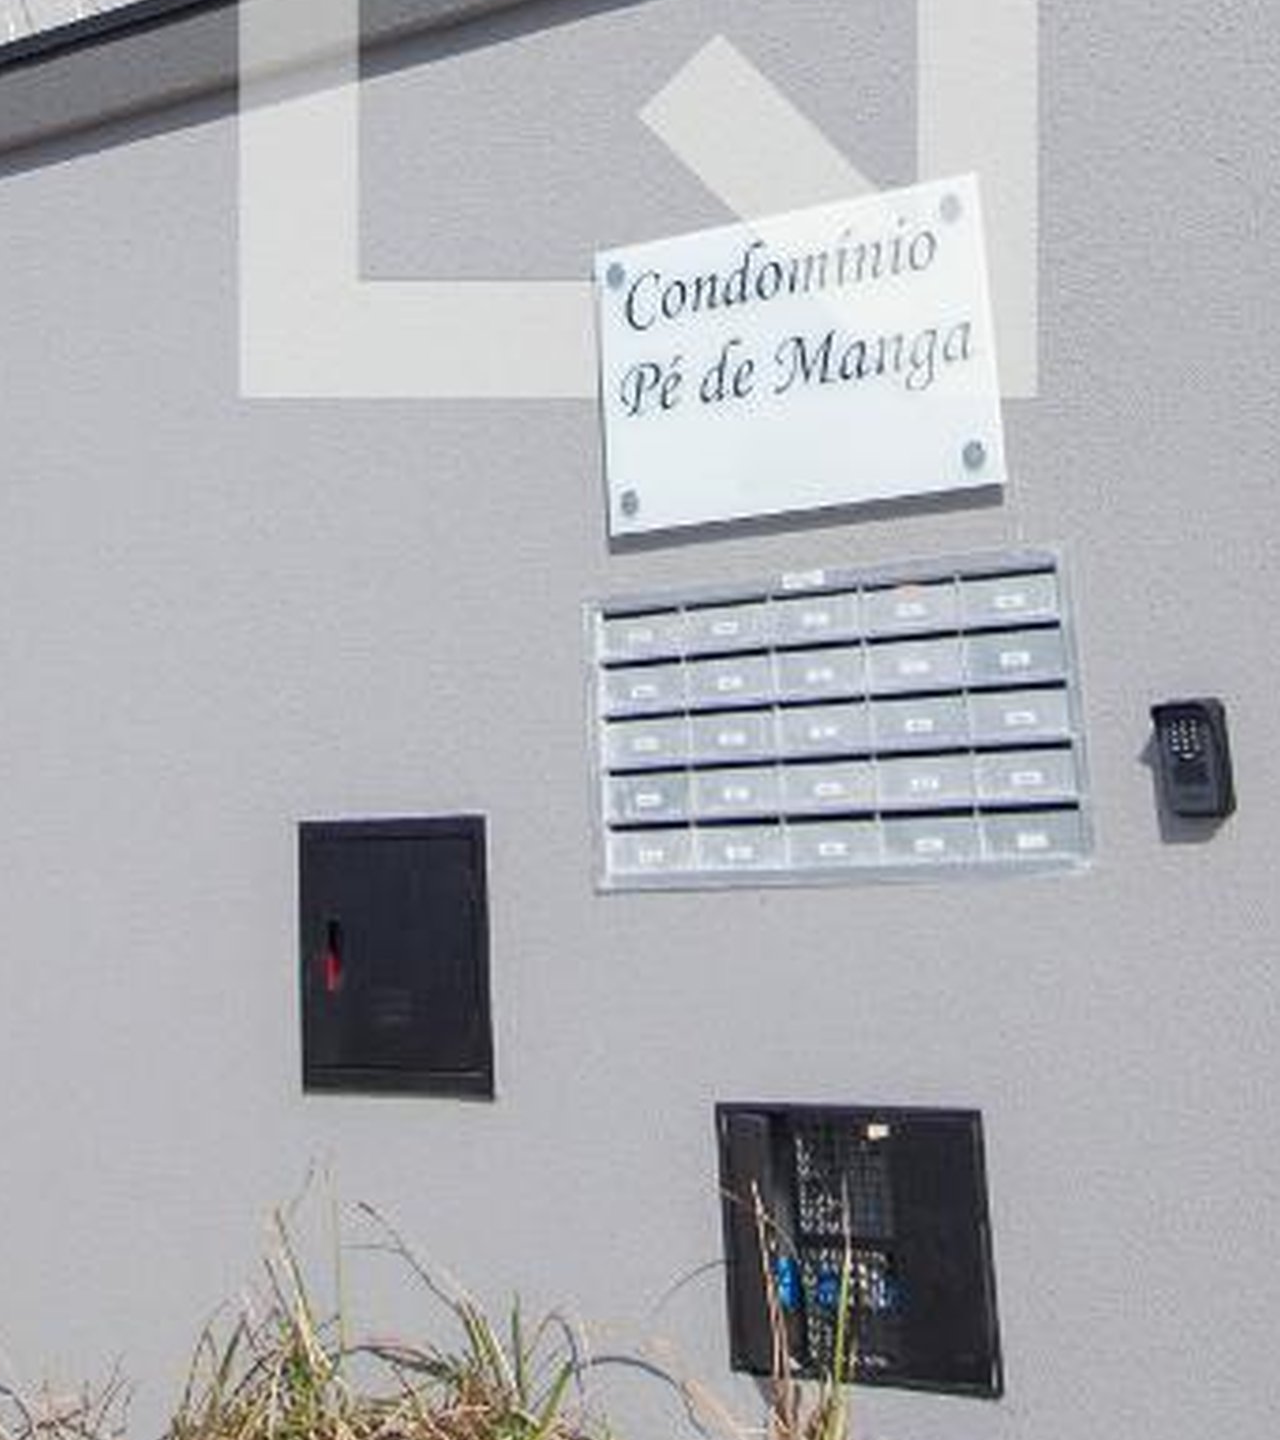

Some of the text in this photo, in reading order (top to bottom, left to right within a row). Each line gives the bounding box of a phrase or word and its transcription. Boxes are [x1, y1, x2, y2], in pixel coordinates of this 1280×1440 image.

[625, 217, 938, 332] Condomínio
[619, 320, 972, 417] Pé de Manga
